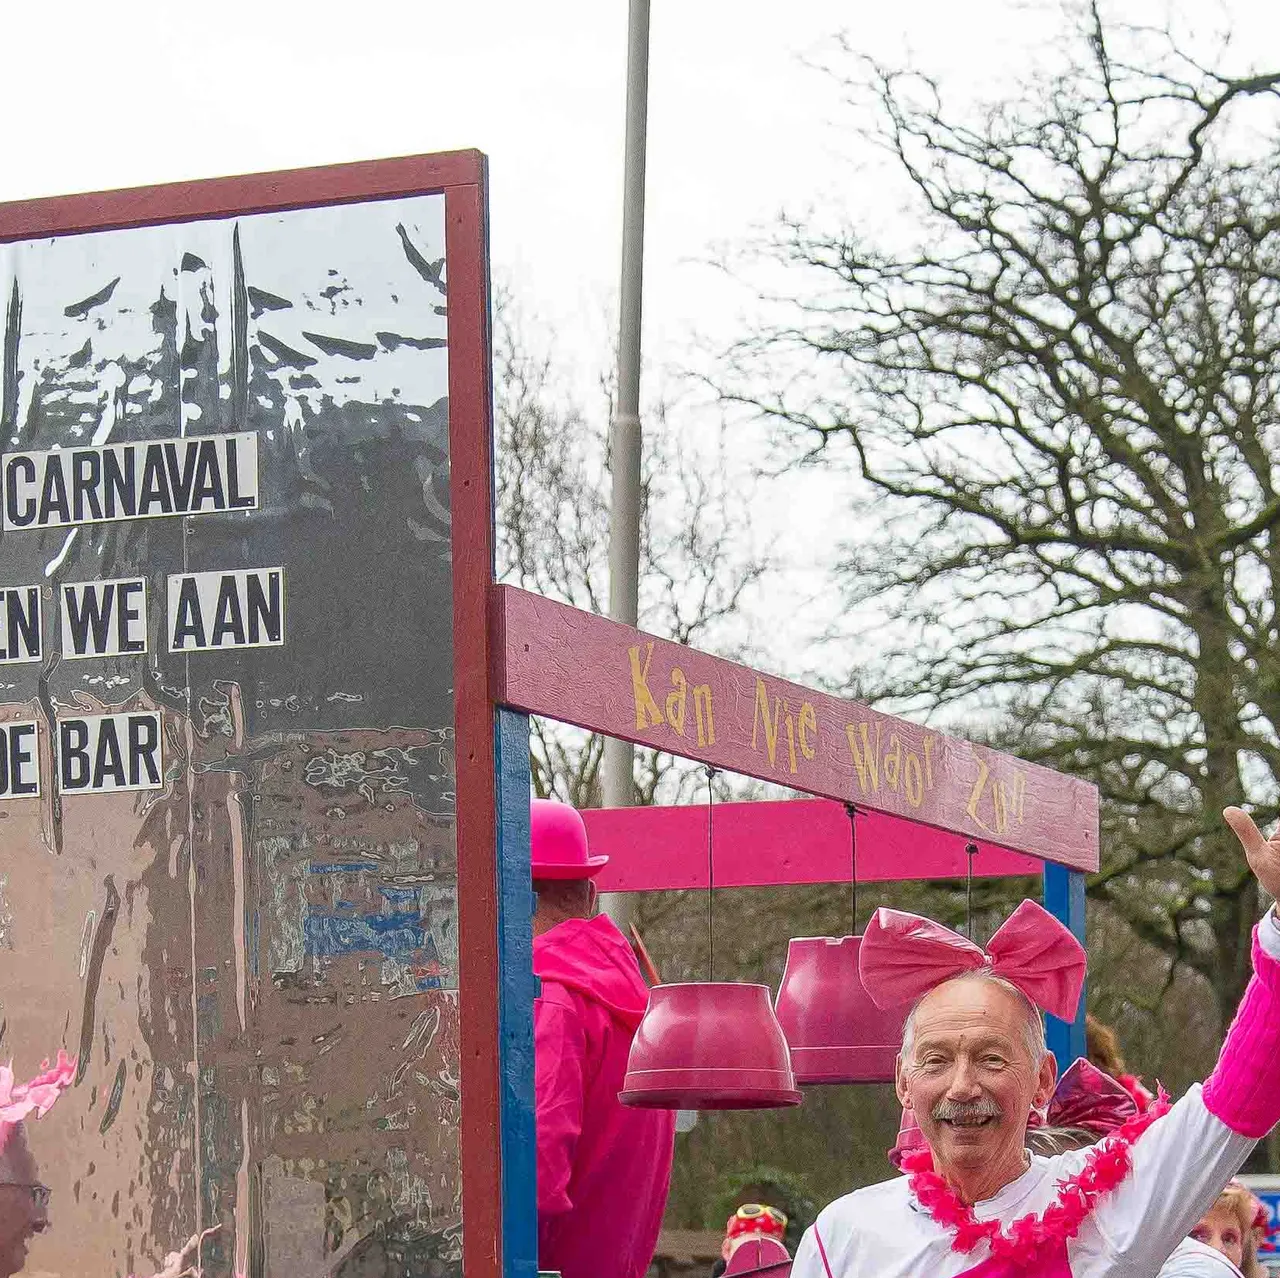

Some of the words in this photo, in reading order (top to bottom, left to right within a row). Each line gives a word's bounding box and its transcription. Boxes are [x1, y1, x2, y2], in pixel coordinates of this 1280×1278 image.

[6, 438, 256, 527] CARNAVAL
[64, 582, 144, 655] WE
[172, 572, 280, 649] AAN
[60, 716, 162, 790] BAR
[628, 641, 716, 748] Kan
[751, 676, 818, 774] Nie
[845, 721, 935, 809] Waor
